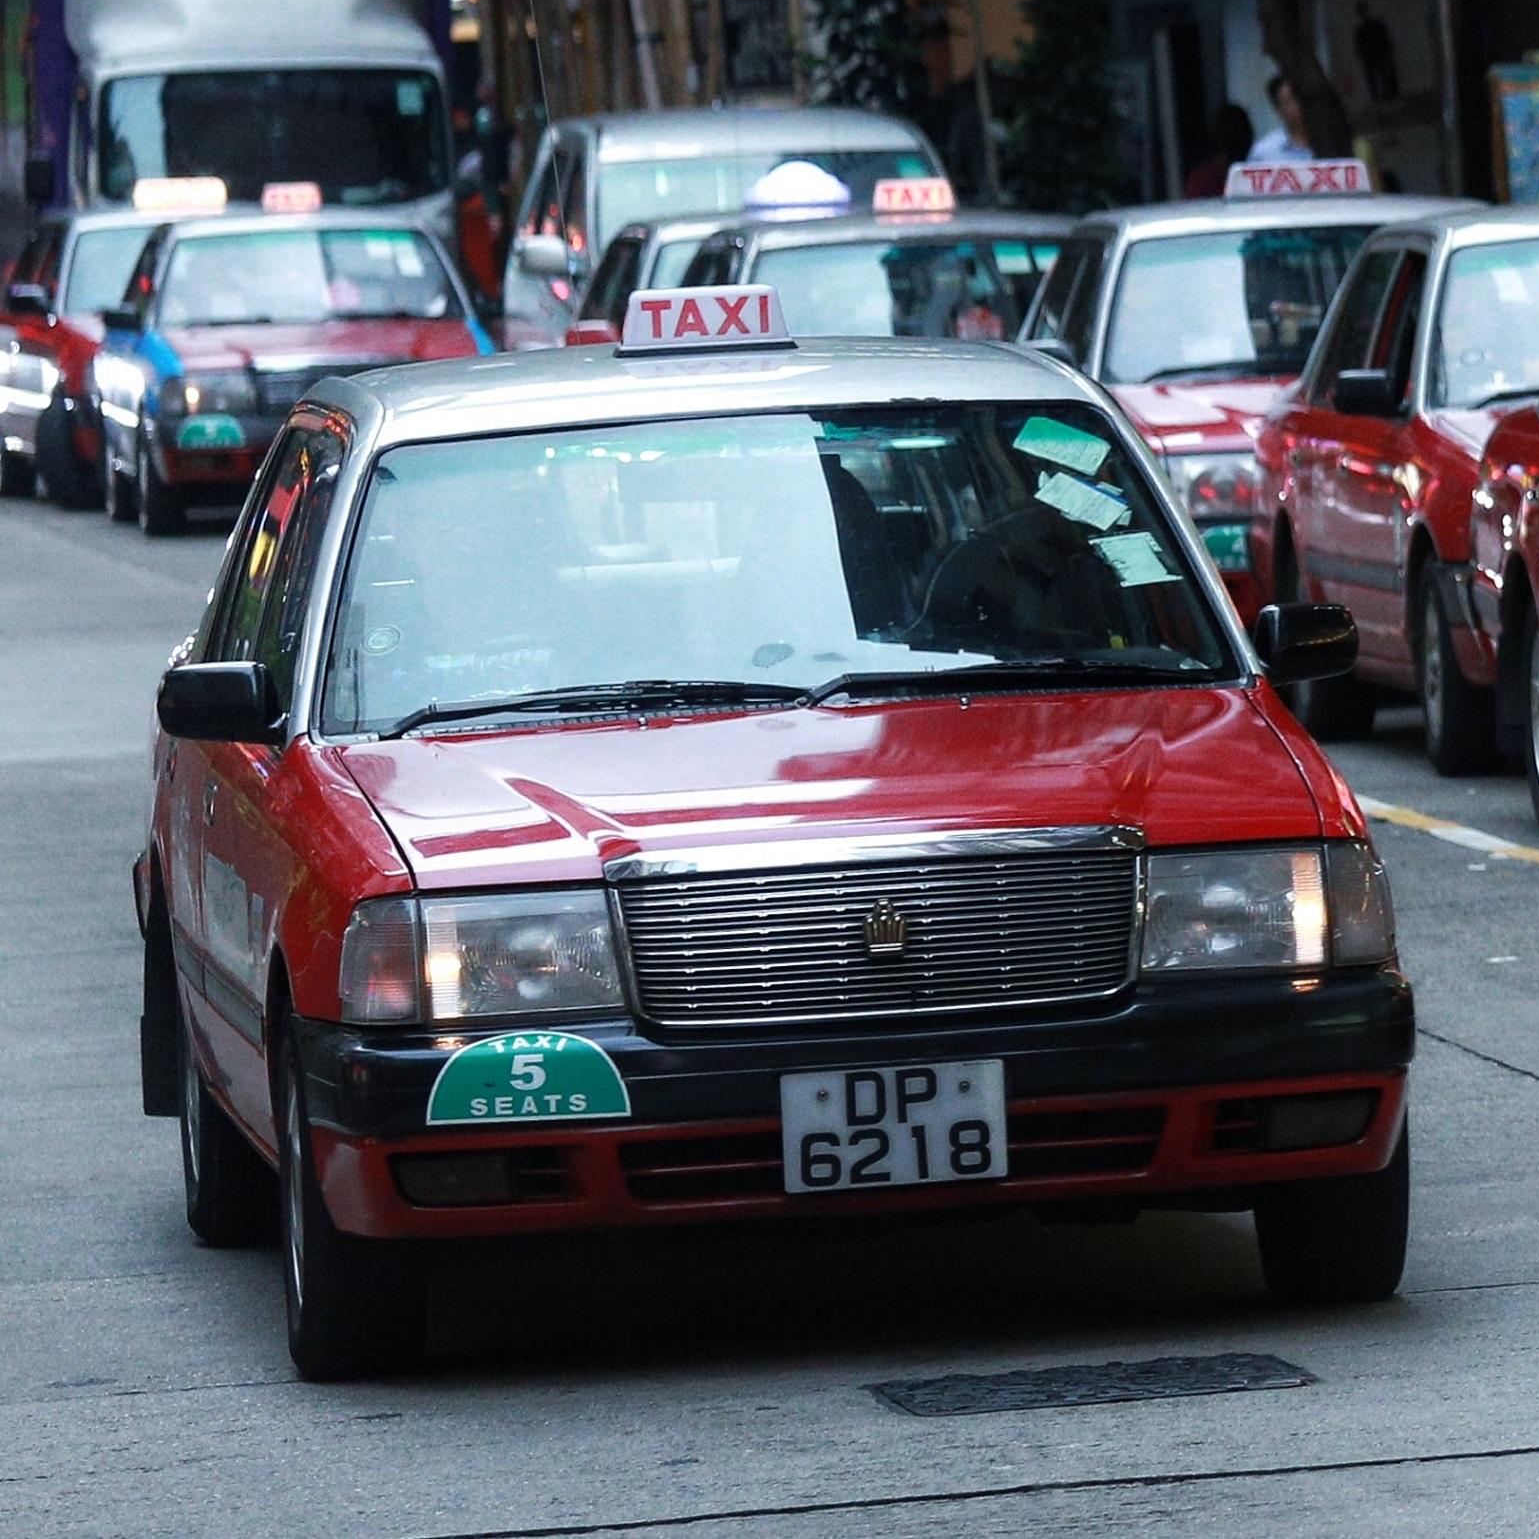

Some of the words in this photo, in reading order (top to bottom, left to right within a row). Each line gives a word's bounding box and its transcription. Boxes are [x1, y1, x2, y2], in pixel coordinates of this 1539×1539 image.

[1242, 165, 1358, 195] TAXI
[641, 295, 769, 339] TAXI
[487, 1035, 567, 1054] TAXI
[508, 1054, 547, 1091] 5
[469, 1093, 588, 1117] SEATS
[843, 1067, 938, 1127] DP
[800, 1119, 992, 1189] 6218
